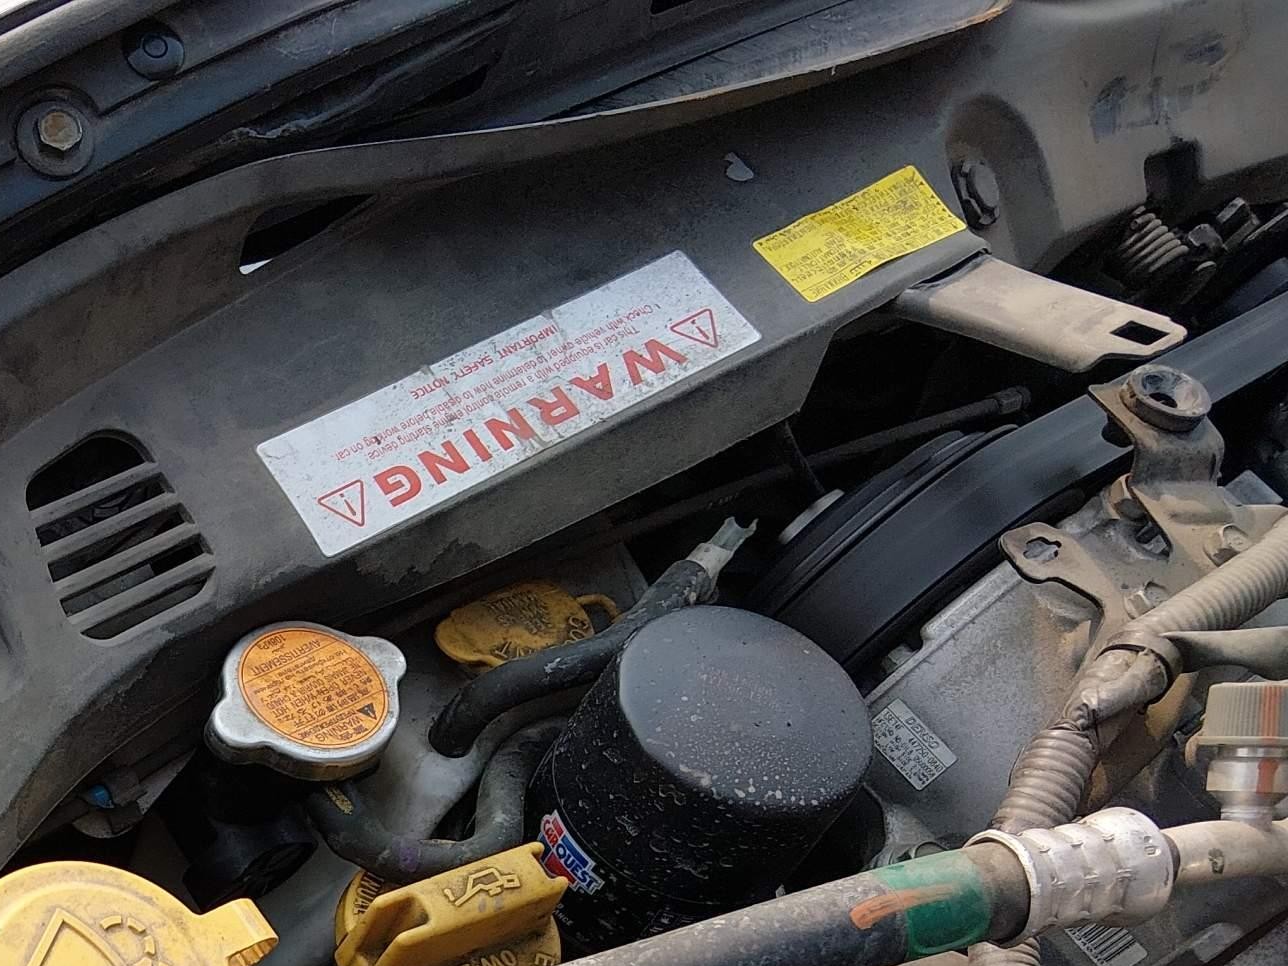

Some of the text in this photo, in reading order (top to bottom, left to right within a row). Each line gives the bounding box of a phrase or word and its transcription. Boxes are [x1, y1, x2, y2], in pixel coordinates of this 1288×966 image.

[621, 301, 654, 325] Check
[603, 315, 626, 334] with
[615, 322, 639, 342] This
[573, 324, 607, 349] vehicle
[592, 339, 604, 352] is
[600, 331, 618, 347] car
[535, 353, 548, 366] to
[545, 339, 575, 360] owner
[550, 341, 595, 373] equipped
[408, 321, 558, 402] IMPORTANT SAFETY NOTICE
[491, 357, 539, 388] determine
[525, 373, 534, 383] a
[531, 363, 555, 383] with
[461, 389, 473, 402] to
[471, 378, 494, 397] how
[493, 376, 526, 400] remote
[427, 392, 463, 418] disable
[461, 391, 495, 416] control
[373, 329, 687, 510] WARNING
[397, 408, 430, 433] before
[429, 404, 464, 431] engine
[395, 420, 433, 448] starting
[329, 446, 351, 464] car.
[349, 441, 364, 454] on
[255, 632, 286, 653] 108kPa
[249, 638, 321, 677] AVERTISSEMENT
[289, 690, 315, 709] WHEN
[314, 680, 339, 698] OPEN
[270, 704, 290, 719] HOT
[314, 714, 362, 743] WARNING
[904, 714, 940, 750] DENSO
